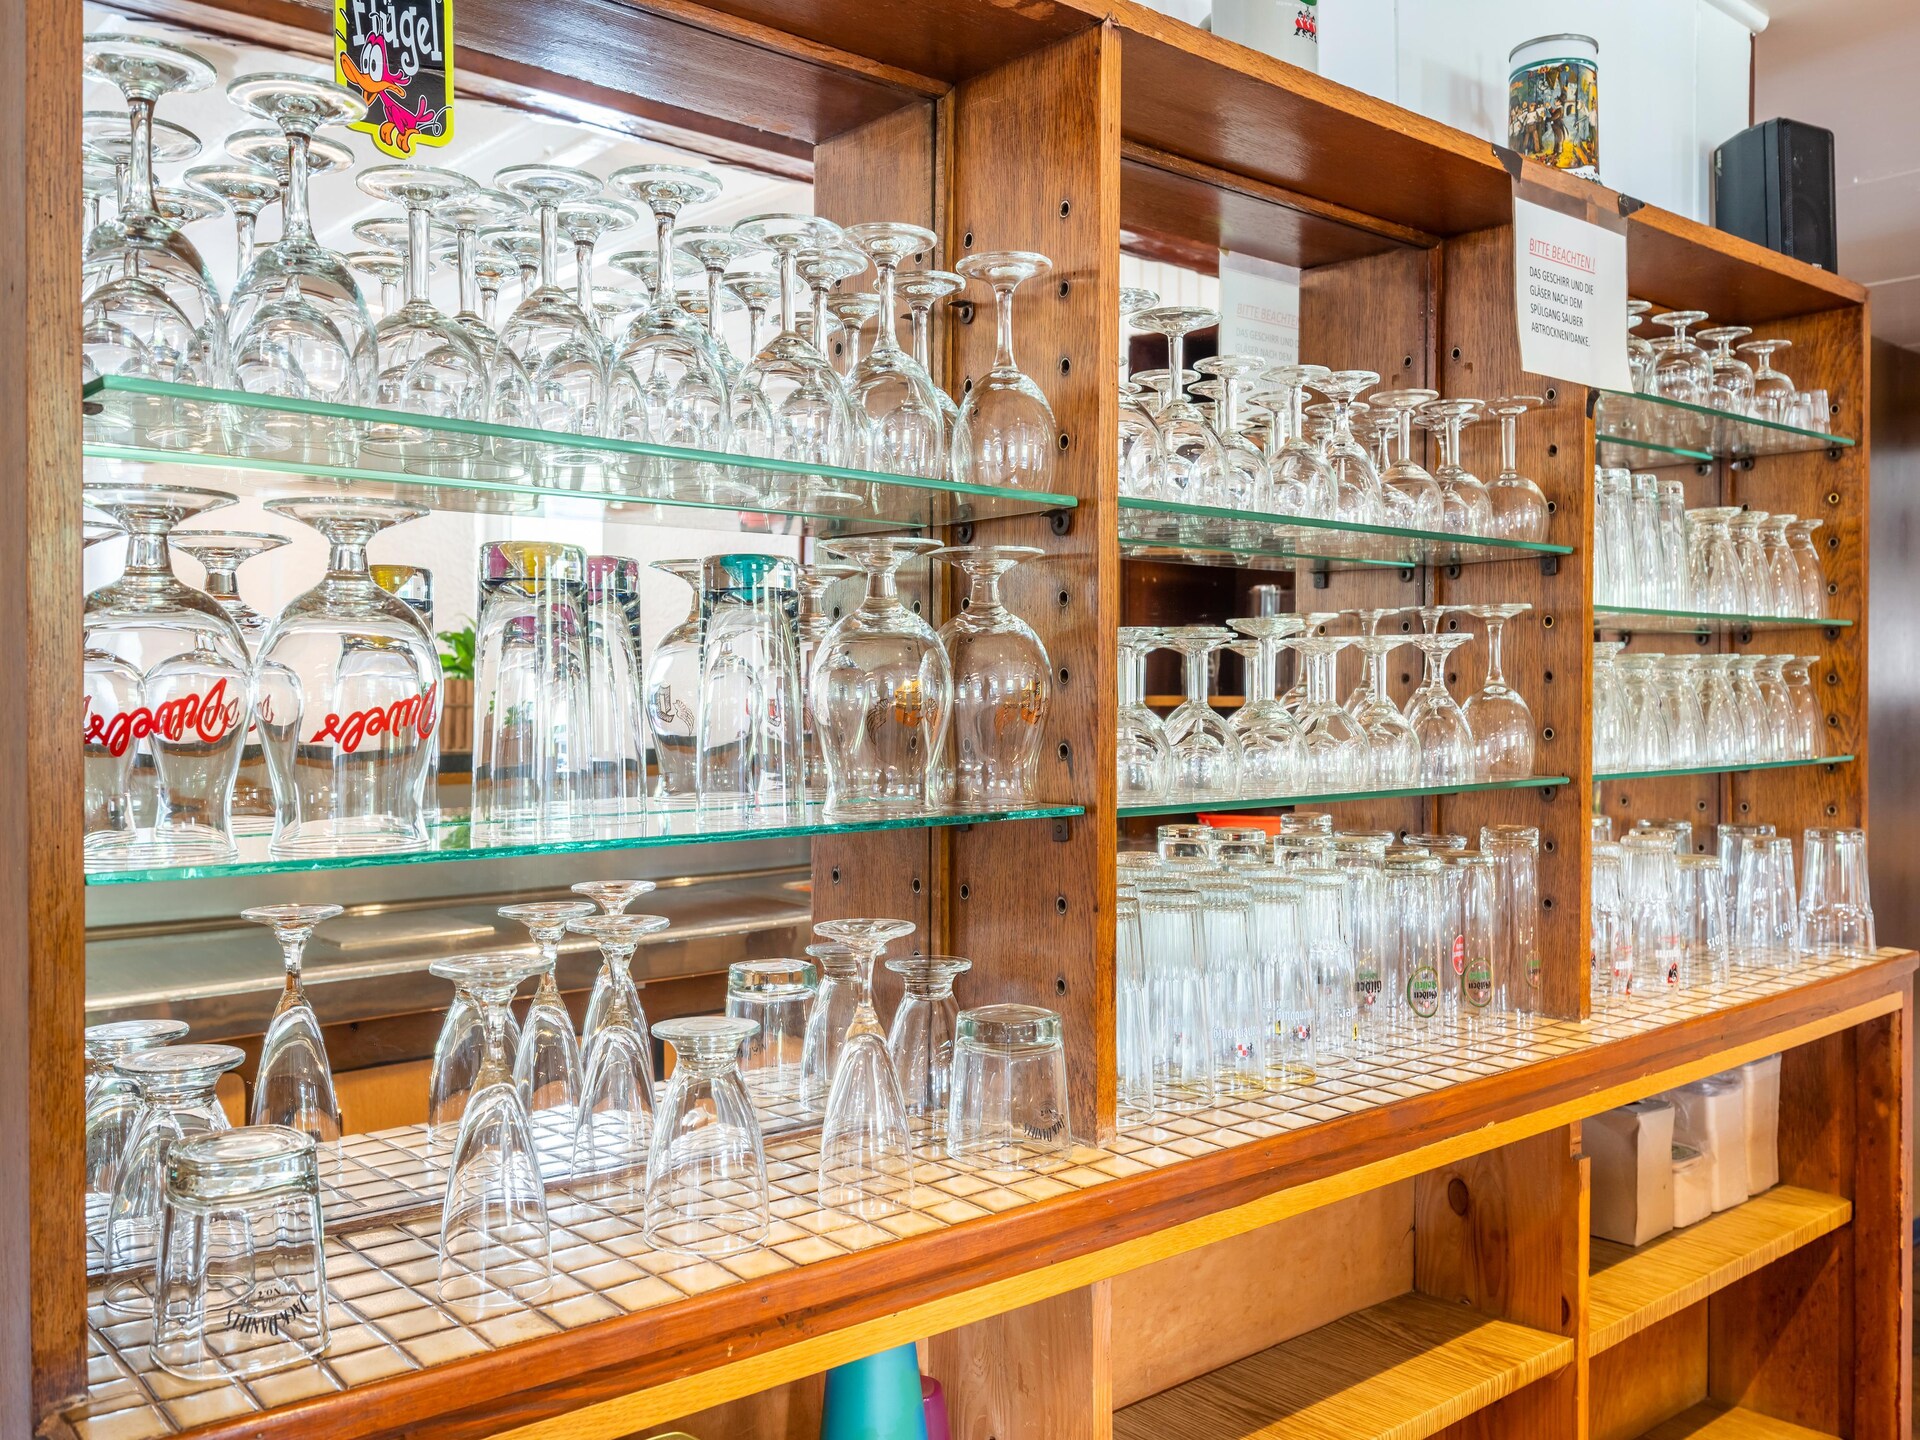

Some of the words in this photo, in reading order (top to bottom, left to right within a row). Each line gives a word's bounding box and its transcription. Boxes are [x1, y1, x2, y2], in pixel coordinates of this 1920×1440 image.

[1529, 238, 1550, 256] BITTE
[1552, 245, 1590, 269] BEACHTEN
[1529, 266, 1541, 279] DAS
[1542, 271, 1570, 287] GESCHIRR
[1570, 279, 1583, 292] UND
[1584, 283, 1594, 295] DIE
[1529, 284, 1551, 300] GLÄSER
[1552, 292, 1568, 305] NACH
[1569, 297, 1583, 309] DEM
[1236, 303, 1261, 318] BITTE
[1530, 302, 1561, 321] SPÜLGANG
[1561, 312, 1584, 327] SAUBER
[279, 1293, 309, 1327] JACK
